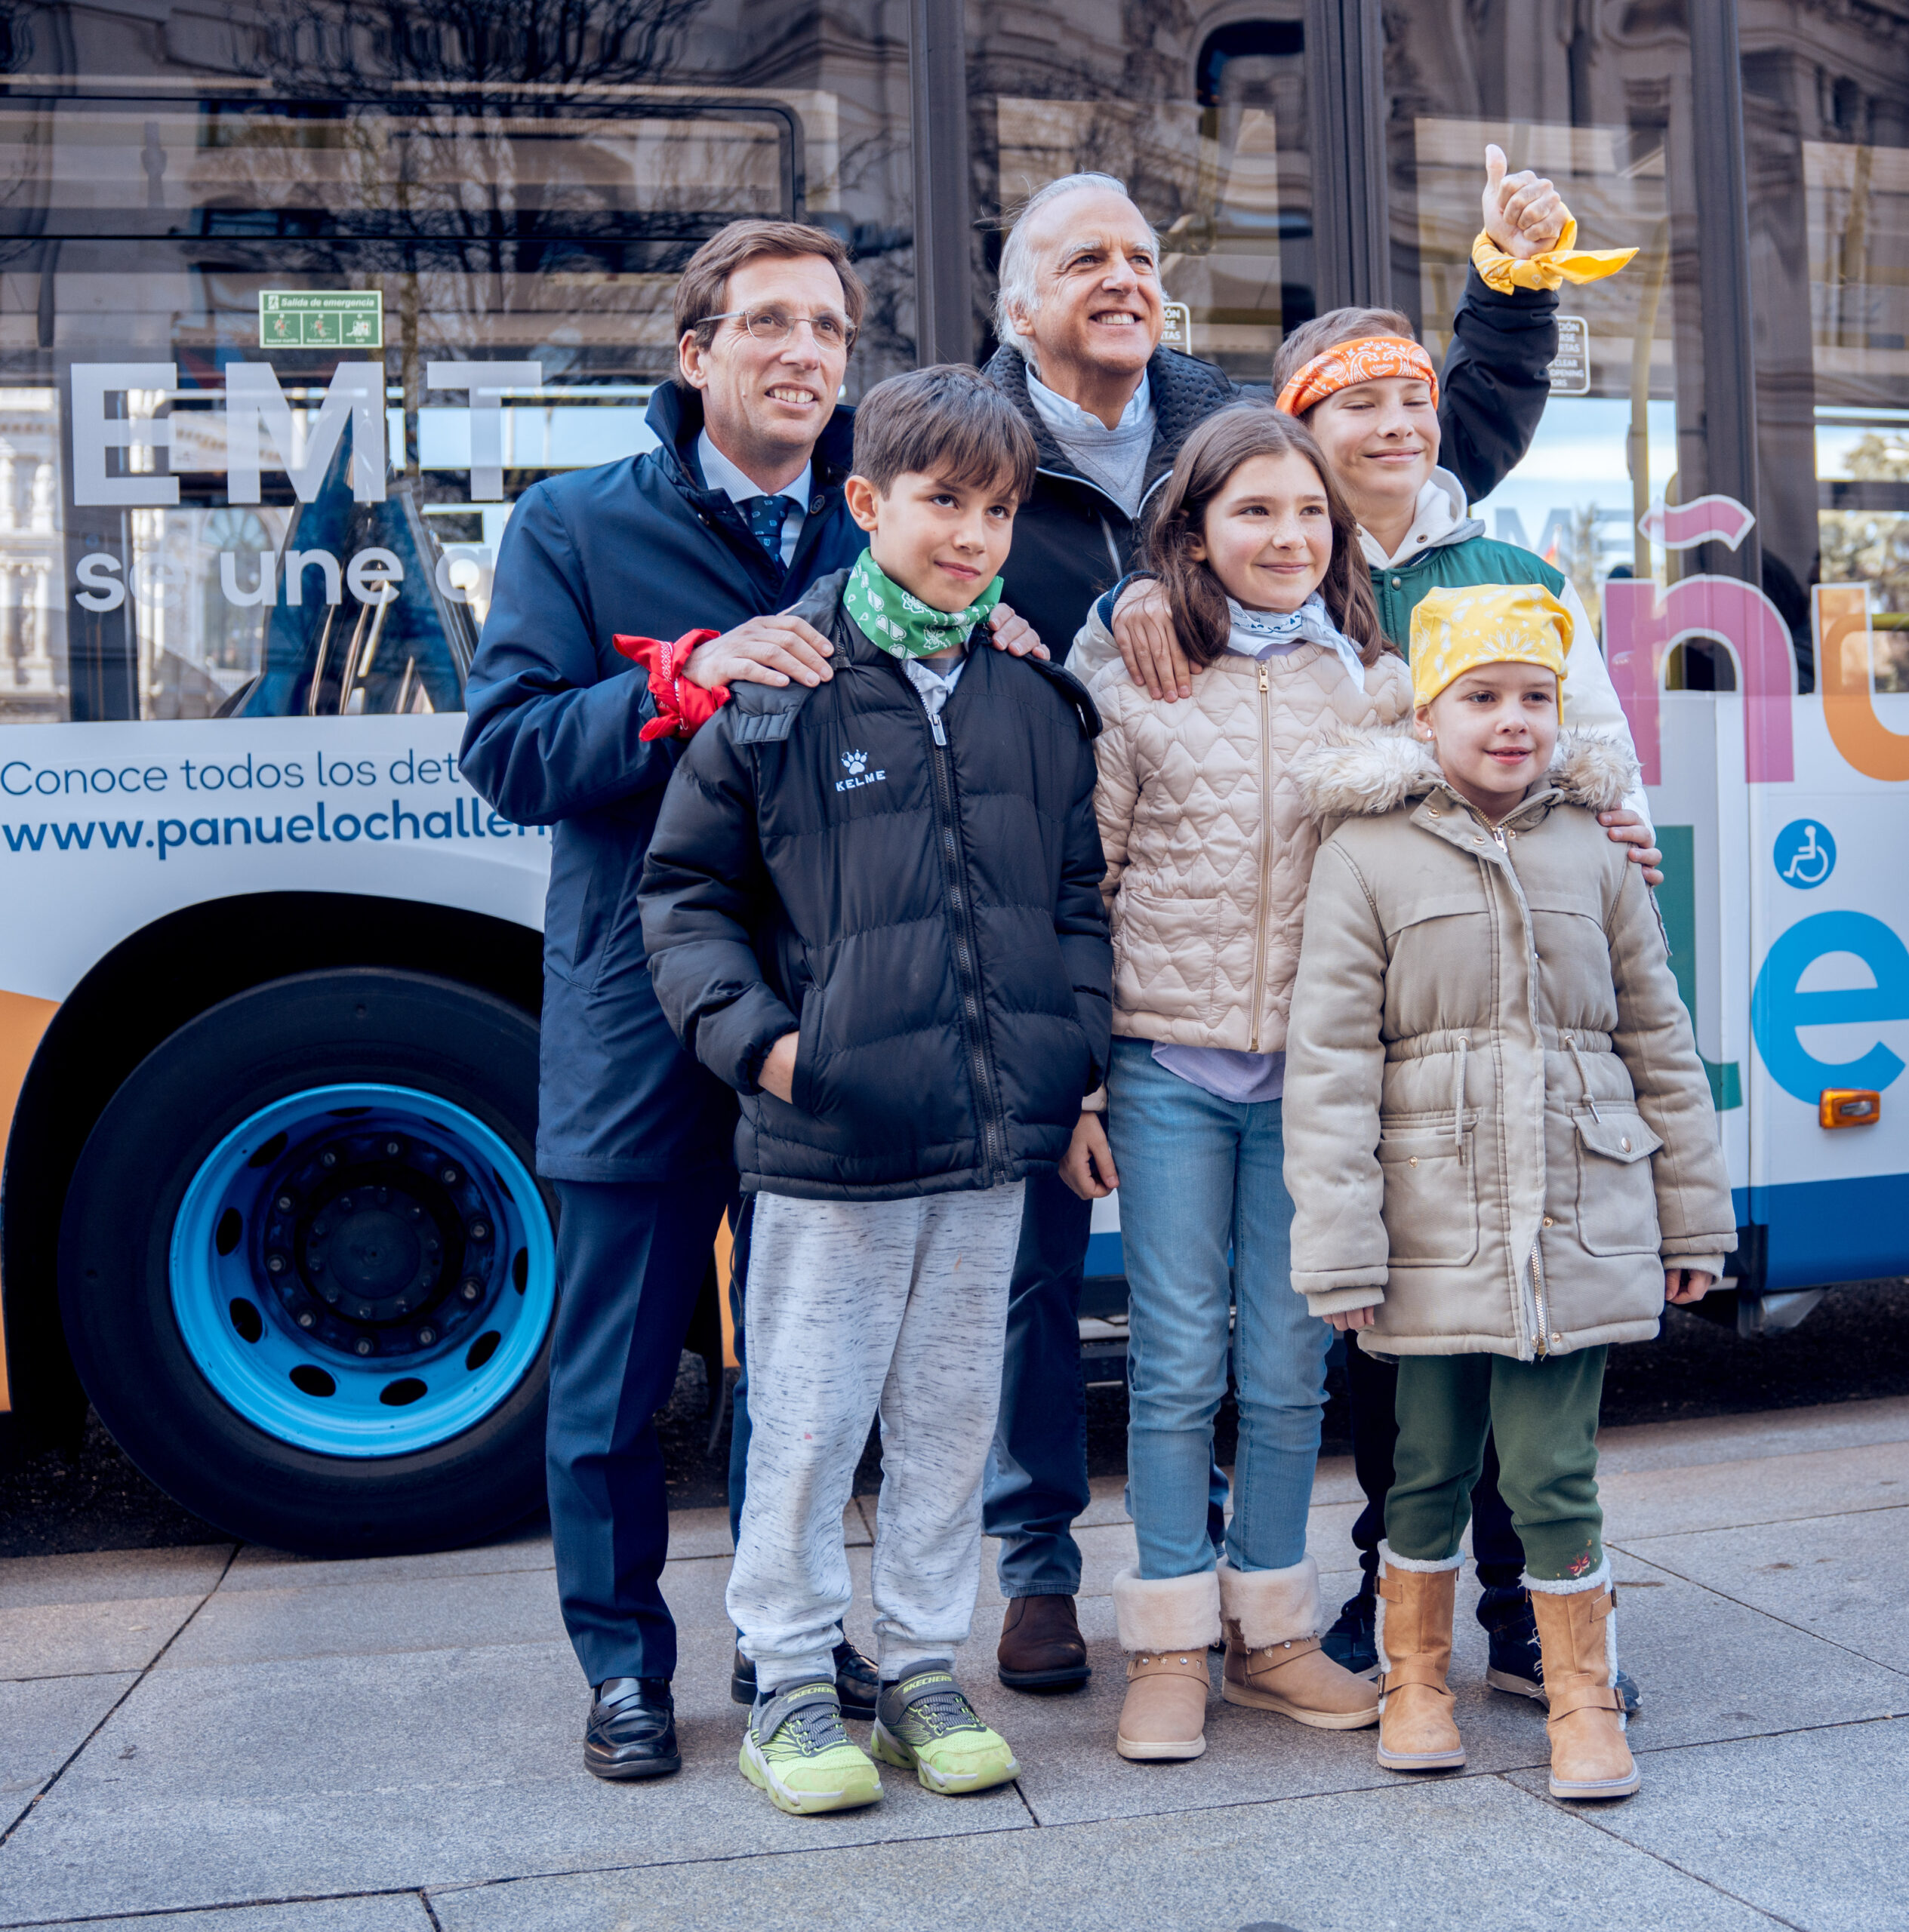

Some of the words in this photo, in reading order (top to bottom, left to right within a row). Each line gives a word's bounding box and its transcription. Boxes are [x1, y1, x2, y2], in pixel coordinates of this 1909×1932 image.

[281, 297, 308, 307] Salida
[310, 297, 321, 307] de
[323, 297, 375, 309] emergencia
[71, 361, 542, 506] EMT
[75, 552, 186, 612] se
[220, 547, 404, 606] une
[1, 761, 168, 795] Conoce
[180, 752, 304, 790] todos
[317, 751, 377, 786] los
[835, 770, 886, 792] KELME
[2, 797, 553, 860] www.panuelochalle
[903, 1675, 953, 1694] SKECHERS
